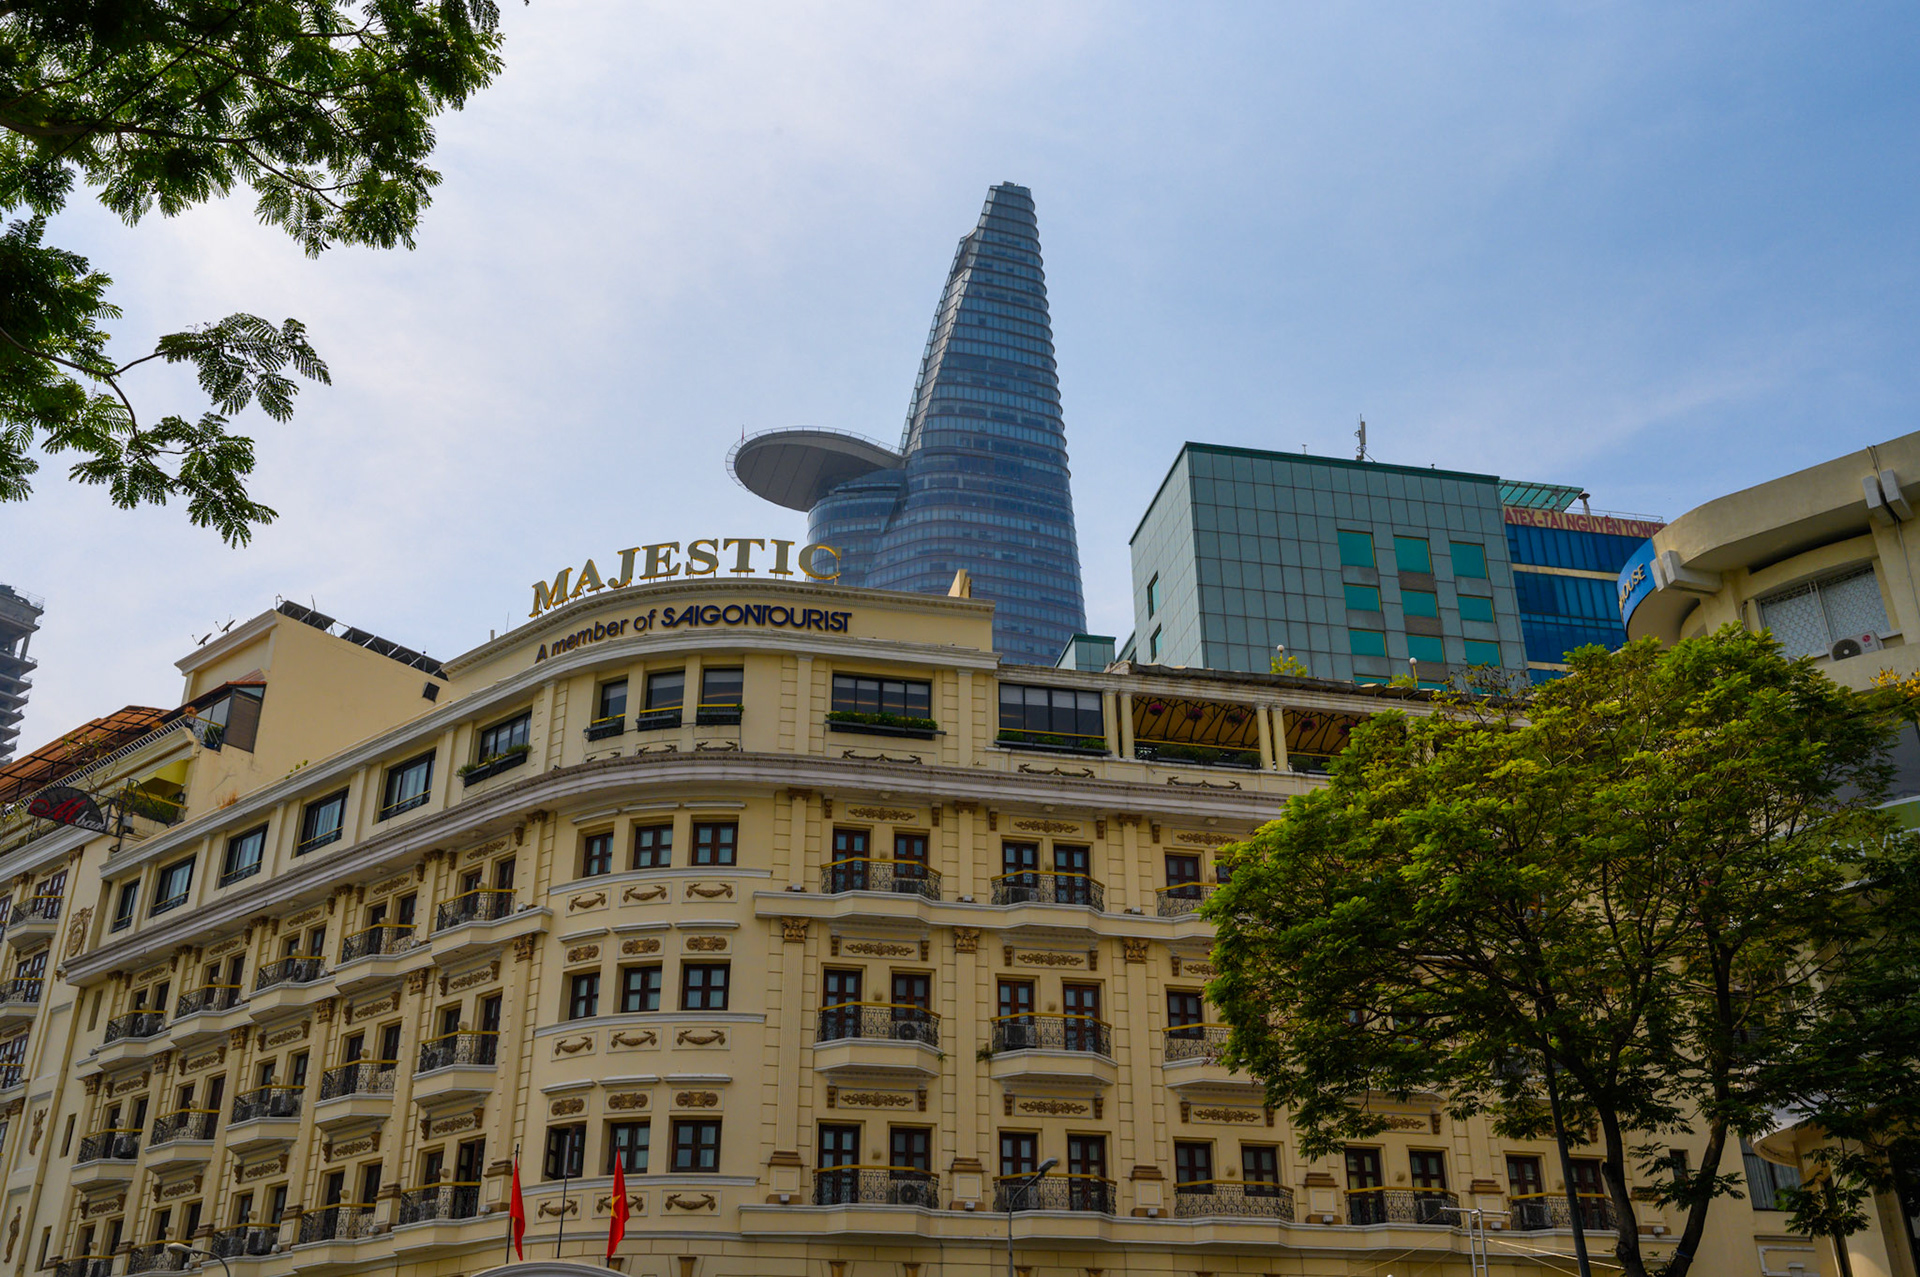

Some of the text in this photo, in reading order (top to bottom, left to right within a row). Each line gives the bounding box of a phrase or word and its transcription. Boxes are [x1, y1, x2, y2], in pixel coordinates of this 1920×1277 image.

[528, 538, 842, 618] MAJESTIC
[535, 604, 852, 664] A member of SAIGONTOURIST
